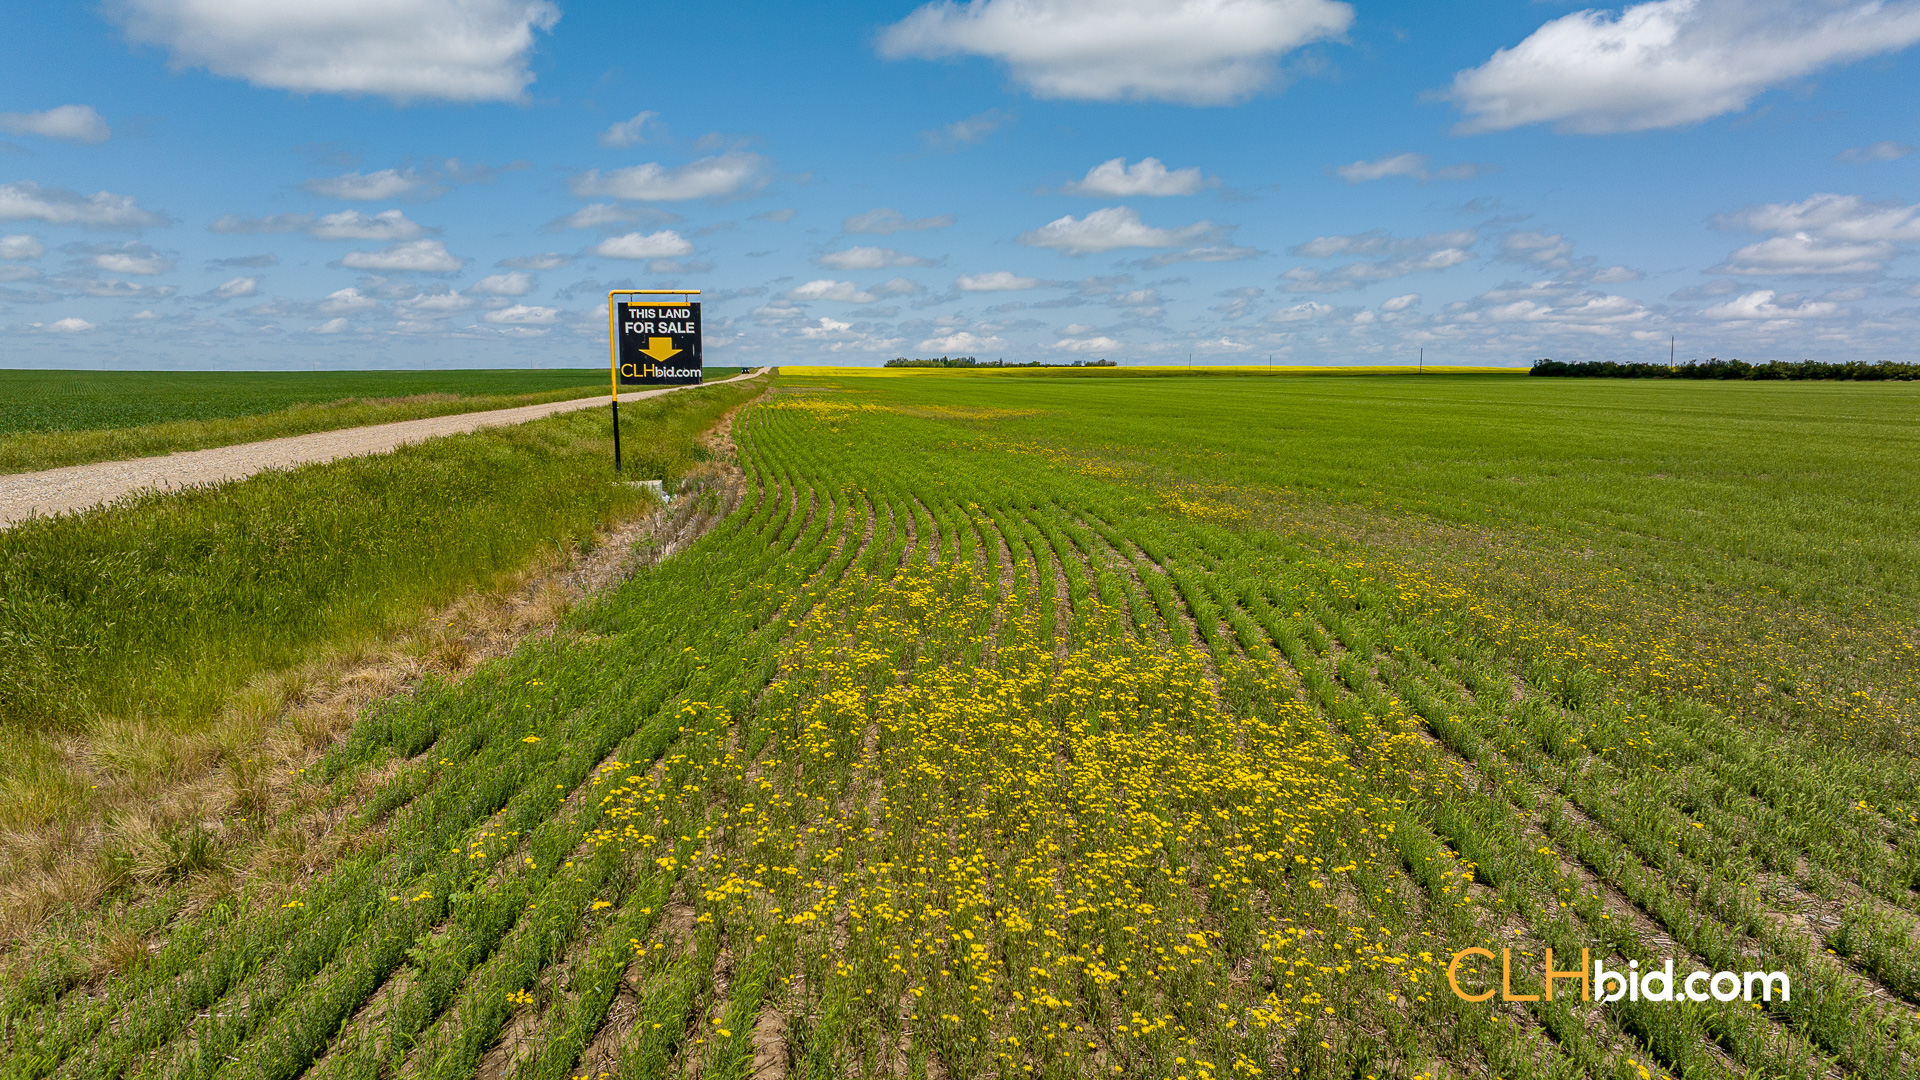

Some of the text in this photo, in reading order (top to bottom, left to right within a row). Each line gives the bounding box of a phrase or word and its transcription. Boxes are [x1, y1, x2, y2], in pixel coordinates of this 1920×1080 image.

[628, 308, 691, 319] THIS LAND
[624, 321, 695, 334] FOR SALE
[620, 363, 702, 378] CLHbid.com
